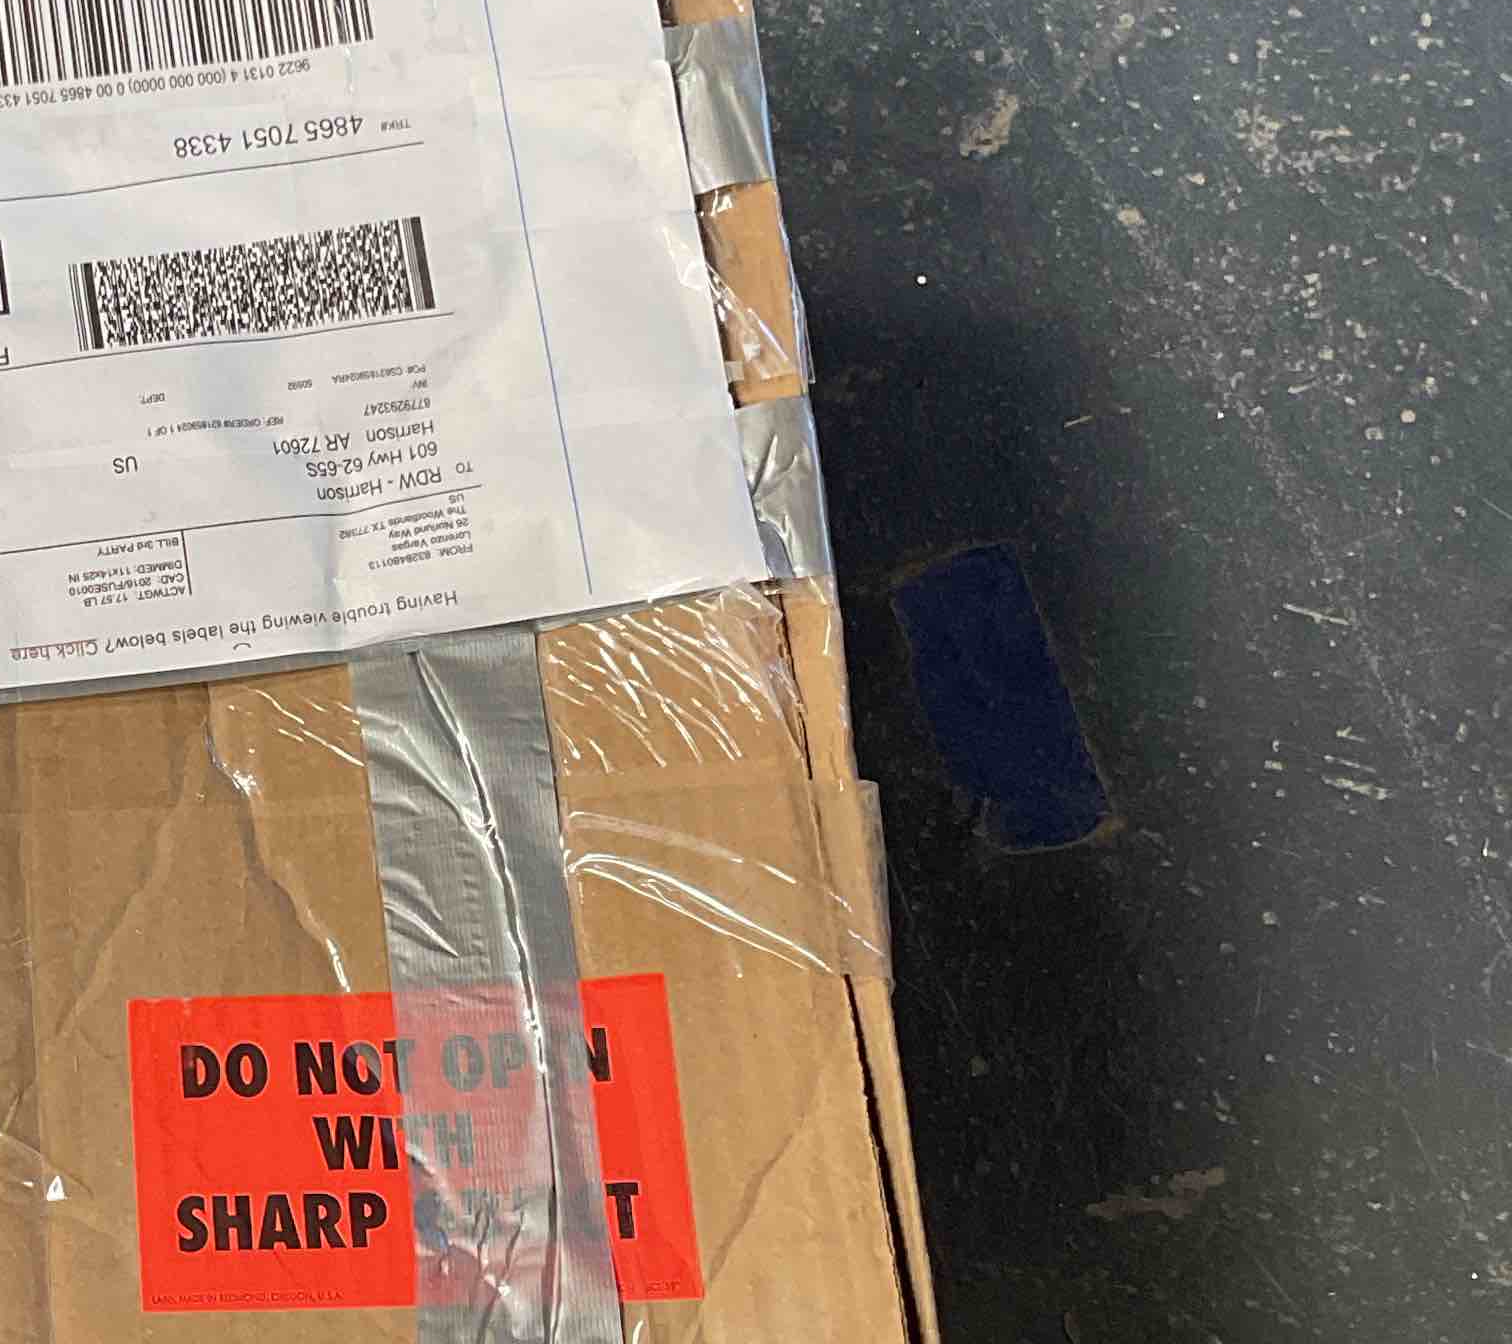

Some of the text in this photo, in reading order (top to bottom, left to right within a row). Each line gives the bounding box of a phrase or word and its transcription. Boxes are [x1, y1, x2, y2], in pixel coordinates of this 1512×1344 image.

[197, 67, 227, 86] (000
[230, 70, 238, 82] 4
[243, 65, 275, 81] 0131
[278, 58, 311, 77] 9622
[116, 81, 125, 97] 0
[128, 76, 166, 94] 0000)
[168, 73, 194, 89] 000
[25, 90, 57, 106] 7051
[60, 86, 93, 102] 4865
[95, 83, 113, 98] 00
[242, 123, 298, 150] 7051
[303, 115, 363, 142] 4865
[173, 133, 232, 159] 4338
[155, 425, 168, 437] OF
[272, 420, 434, 456] Harrison AR 72601
[112, 455, 138, 474] US
[305, 440, 438, 478] 601 Hwy 62-65S
[455, 461, 473, 474] TO
[399, 467, 442, 490] RDW
[316, 478, 383, 502] Harrison
[445, 491, 465, 505] US
[388, 509, 448, 527] Woodlands
[446, 505, 467, 515] The
[371, 521, 386, 532] TX
[388, 528, 412, 539] Way
[97, 536, 179, 557] BILL 3rd PARTY
[391, 530, 472, 552] Lorenzo Vargas
[136, 559, 183, 574] DIMMED:
[68, 573, 80, 583] IN
[83, 596, 98, 608] LB
[9, 590, 458, 661] Having trouble viewing the labels below? Click here
[180, 1044, 268, 1098] DO
[294, 1038, 416, 1096] NOT
[177, 1191, 388, 1253] SHARP
